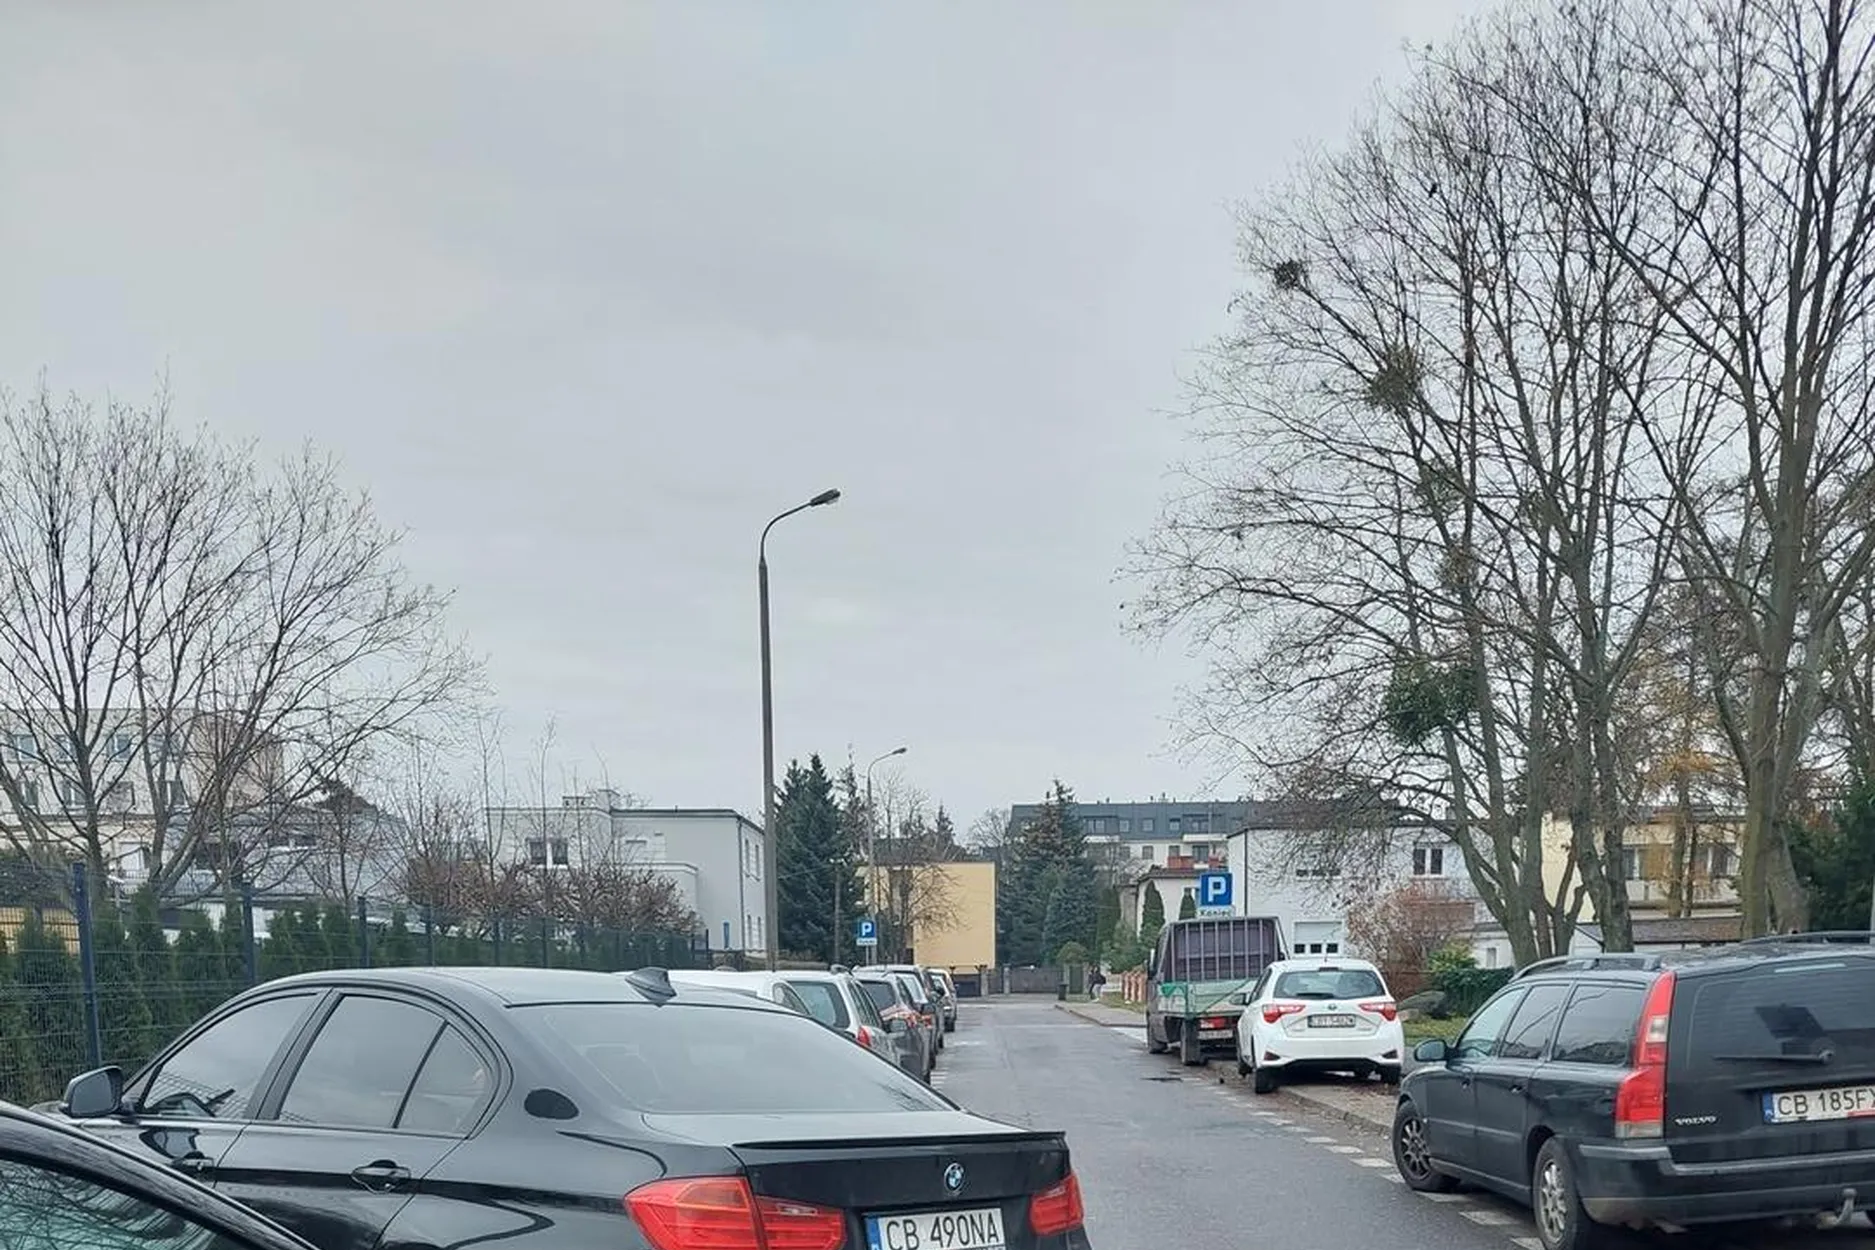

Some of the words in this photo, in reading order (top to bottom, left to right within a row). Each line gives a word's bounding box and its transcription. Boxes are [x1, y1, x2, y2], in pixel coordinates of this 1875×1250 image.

[1208, 876, 1226, 902] P
[861, 922, 872, 936] P
[1778, 1095, 1808, 1115] CB
[1674, 1115, 1718, 1126] VOLVO
[930, 1211, 1000, 1248] 490NA
